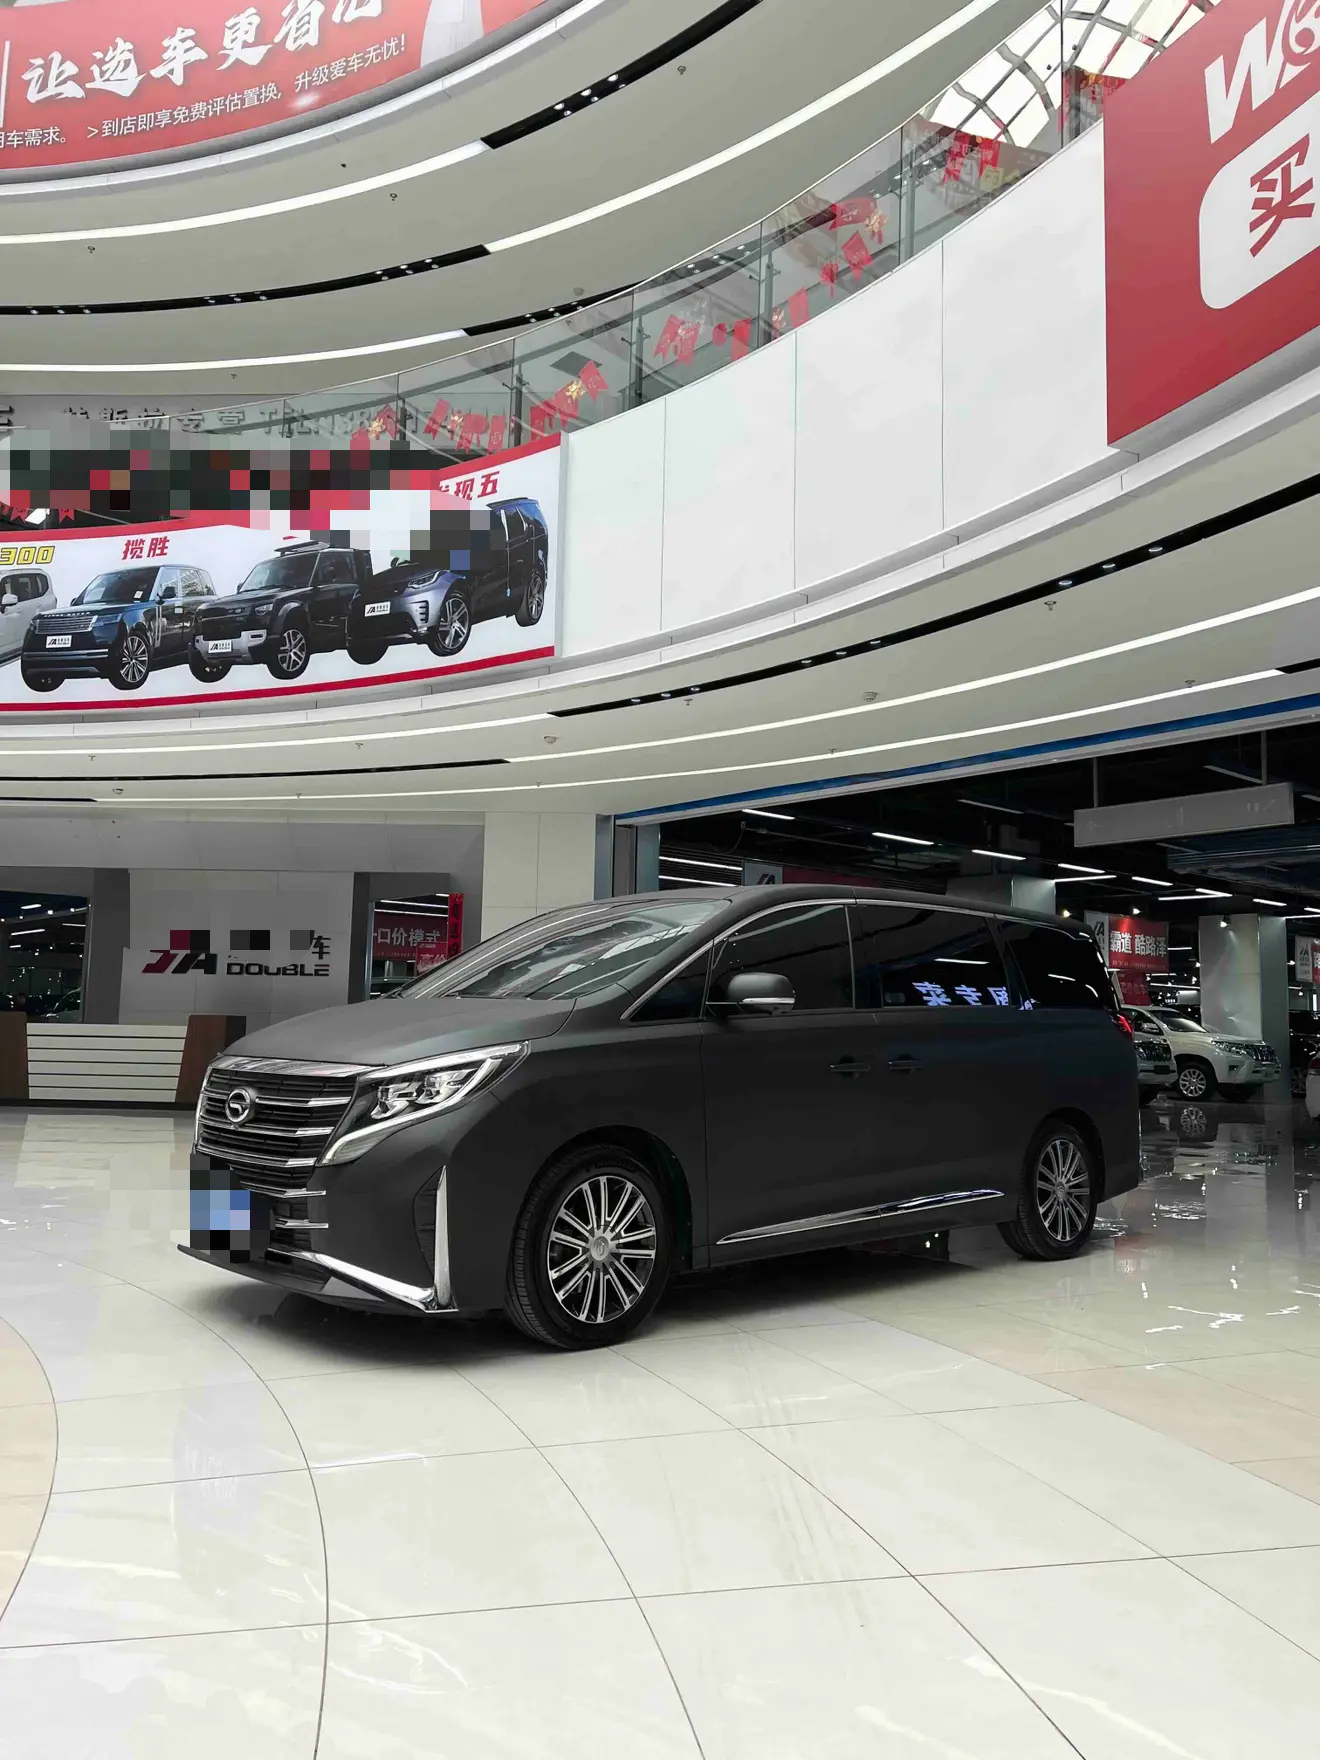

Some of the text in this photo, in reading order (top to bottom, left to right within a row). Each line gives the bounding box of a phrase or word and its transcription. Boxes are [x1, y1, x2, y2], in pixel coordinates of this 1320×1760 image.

[1249, 133, 1316, 258] 买
[121, 535, 170, 561] 揽胜
[1110, 930, 1133, 954] 霸道
[1134, 934, 1168, 957] 酷路泽
